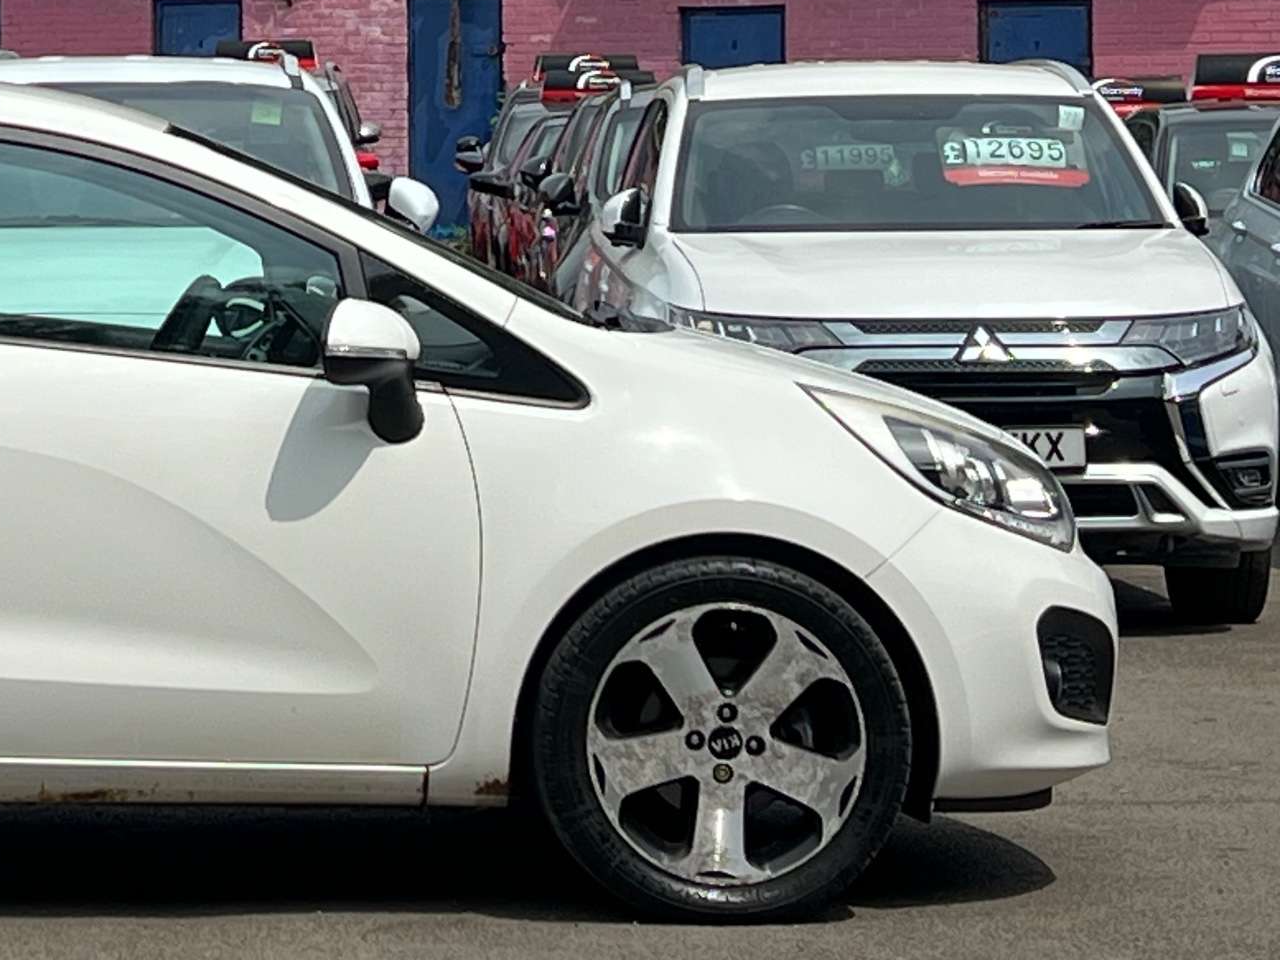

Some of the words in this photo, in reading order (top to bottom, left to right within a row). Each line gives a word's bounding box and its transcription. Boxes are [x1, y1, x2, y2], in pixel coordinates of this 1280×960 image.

[801, 145, 894, 169] £11995
[943, 139, 1064, 164] £12695
[1011, 432, 1065, 461] KX
[710, 733, 740, 753] KIA
